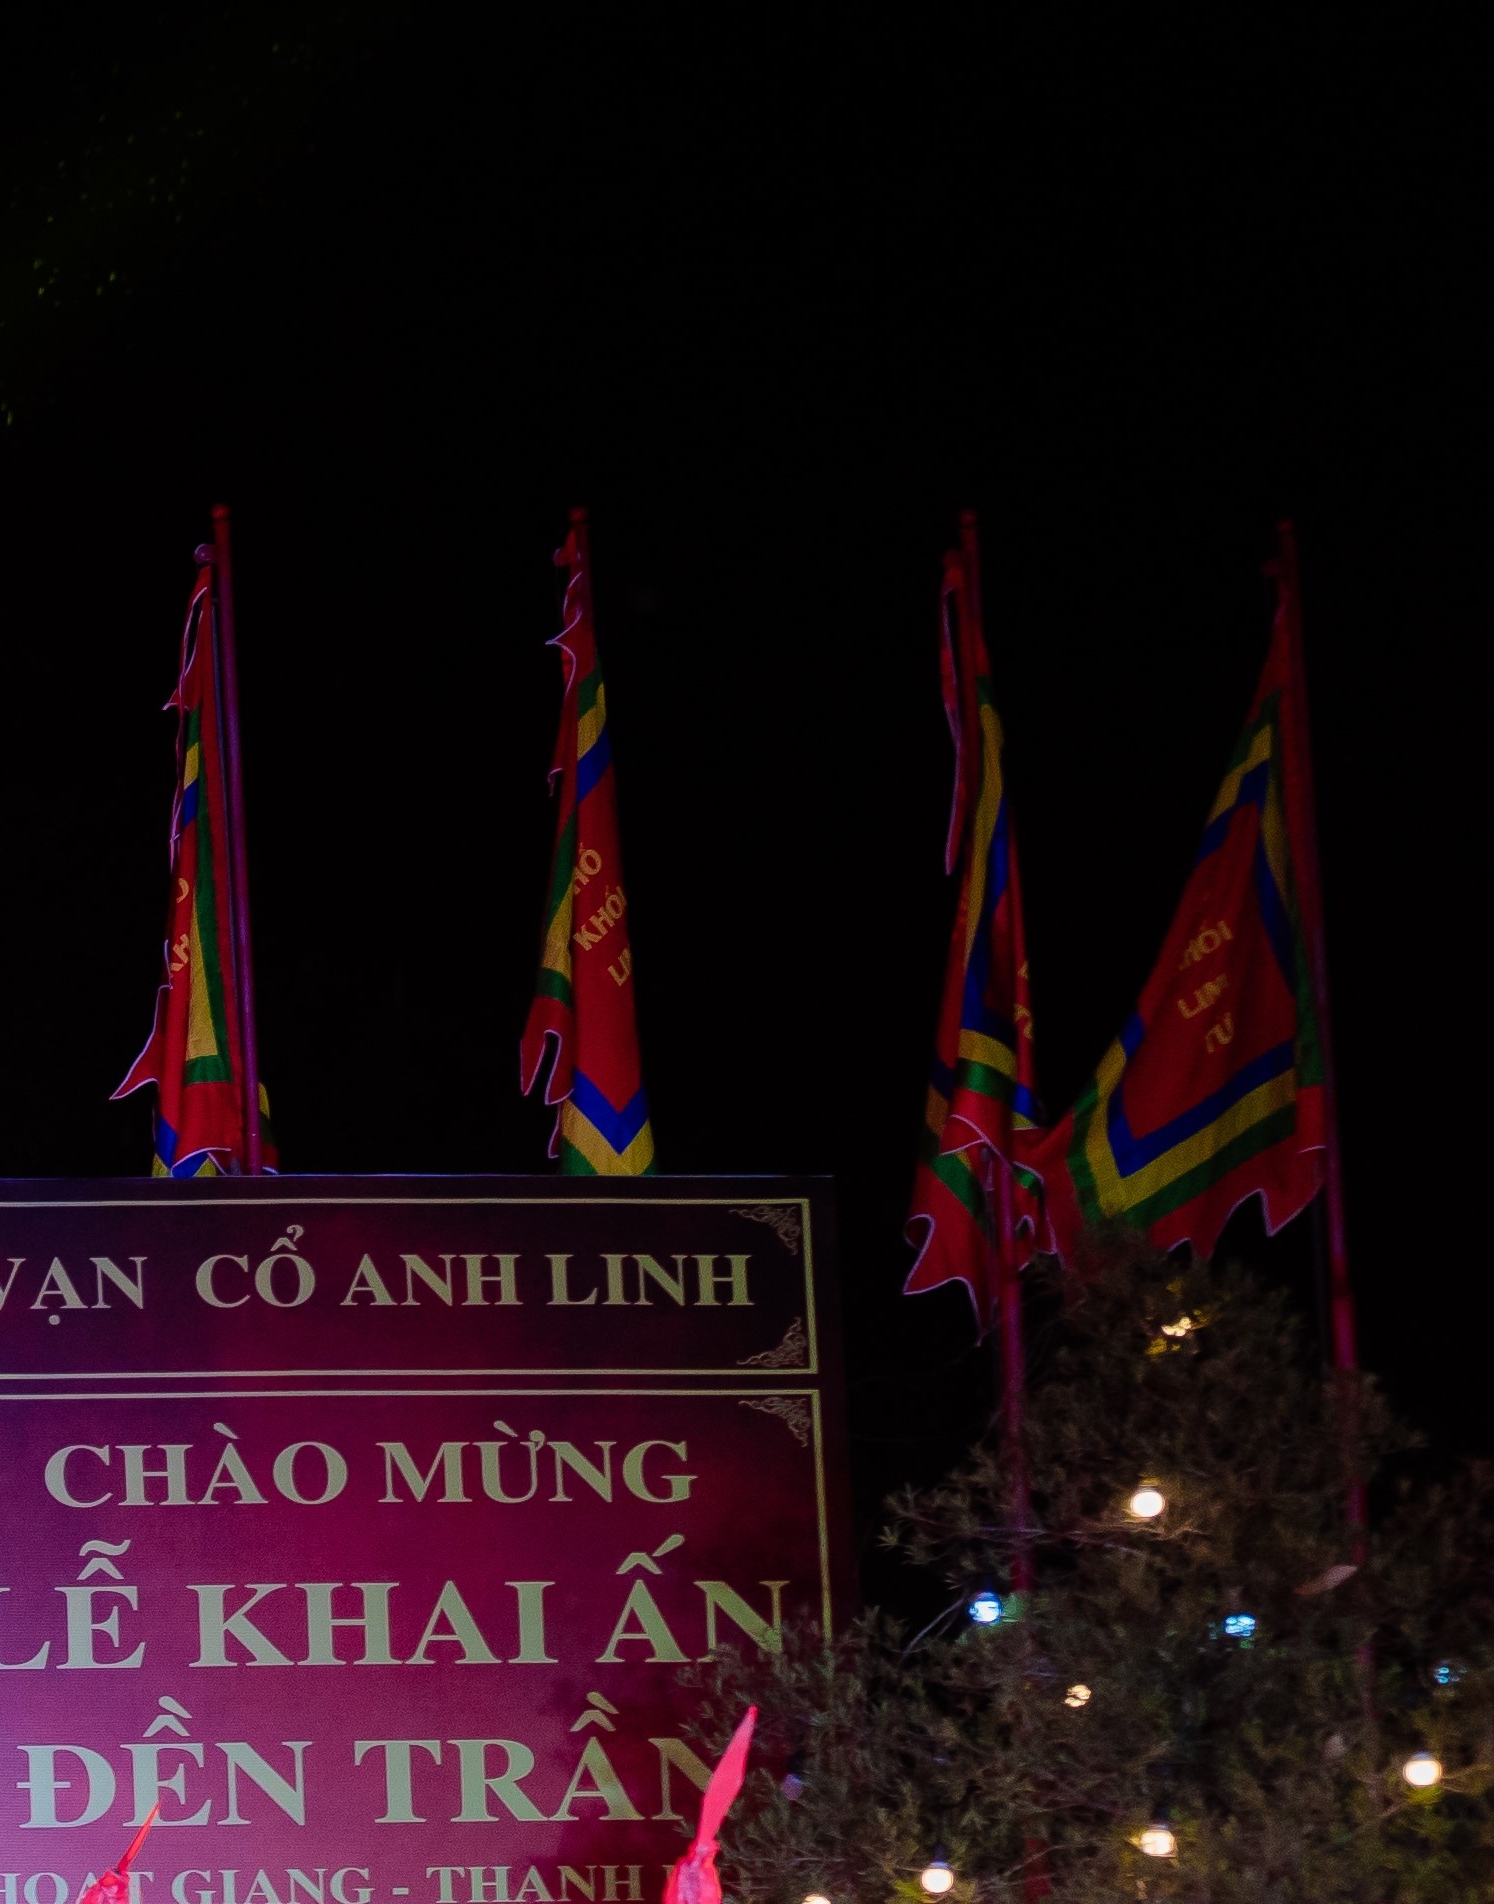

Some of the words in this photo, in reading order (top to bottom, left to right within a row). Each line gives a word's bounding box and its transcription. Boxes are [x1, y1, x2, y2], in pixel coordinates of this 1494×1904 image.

[195, 1224, 316, 1308] CỔ
[340, 1253, 522, 1306] ANH
[545, 1253, 754, 1306] LINH
[44, 1422, 348, 1509] CHÀO
[377, 1420, 697, 1504] MỪNG
[186, 1580, 558, 1668] KHAI
[595, 1533, 791, 1663] ẤN
[16, 1695, 312, 1829] ĐỀN
[425, 1865, 646, 1904] THANH
